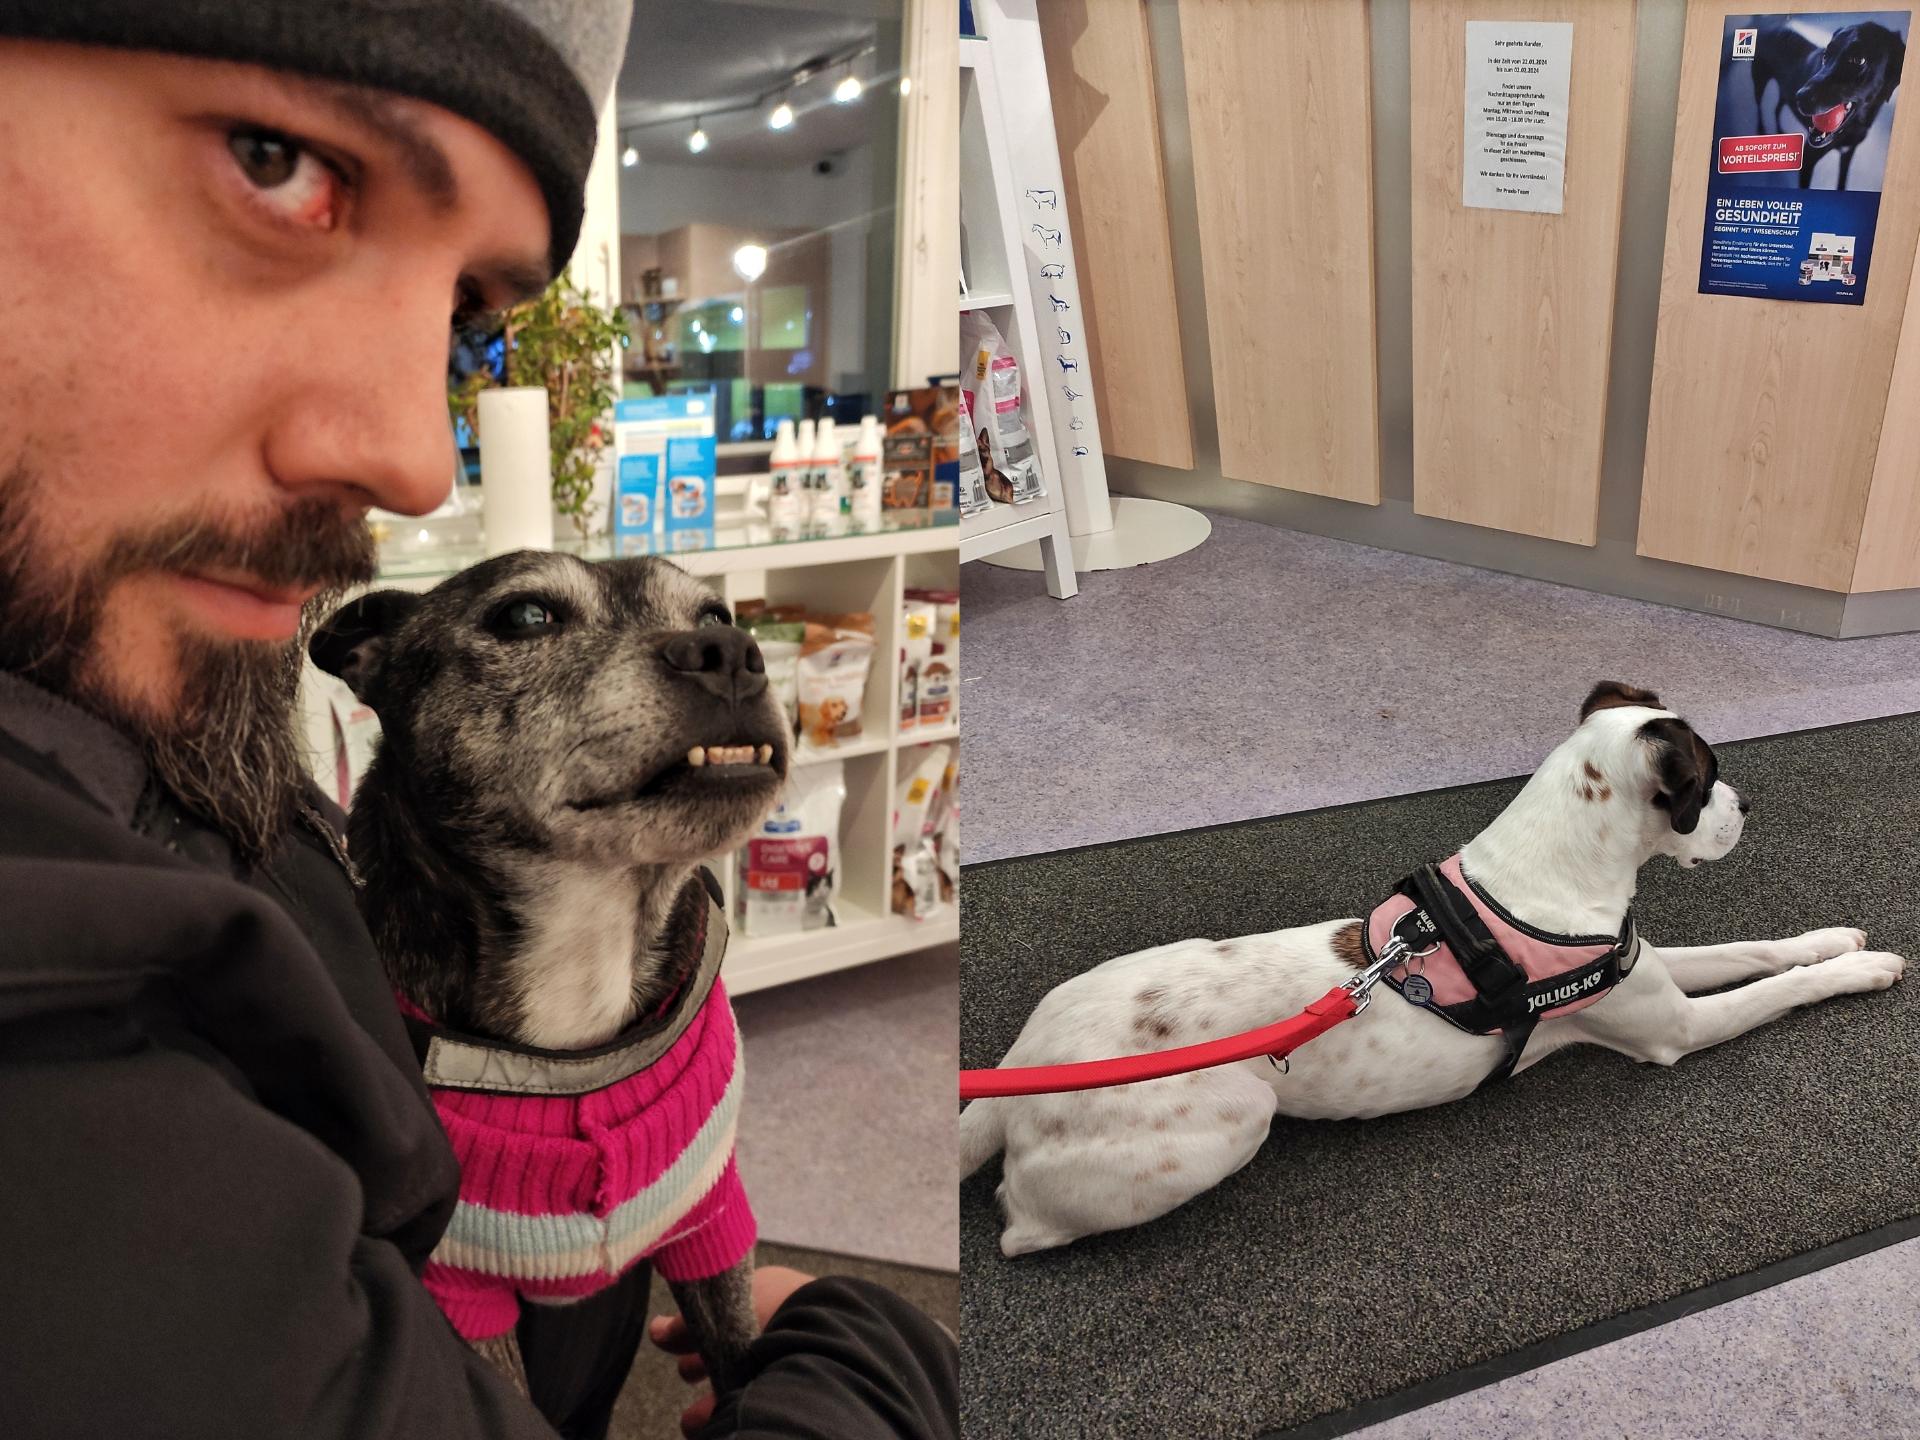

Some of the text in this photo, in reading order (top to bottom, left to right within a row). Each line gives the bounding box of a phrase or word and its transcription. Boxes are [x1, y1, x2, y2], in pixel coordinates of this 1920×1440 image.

[1745, 144, 1771, 152] SOFORT
[1716, 198, 1803, 211] EIN LEBEN VOLLER
[1715, 209, 1801, 224] GESUNDHEIT
[1714, 225, 1739, 233] BEGINNT
[1753, 228, 1799, 236] WISSENSCHAFT
[1417, 909, 1437, 932] JULIUS
